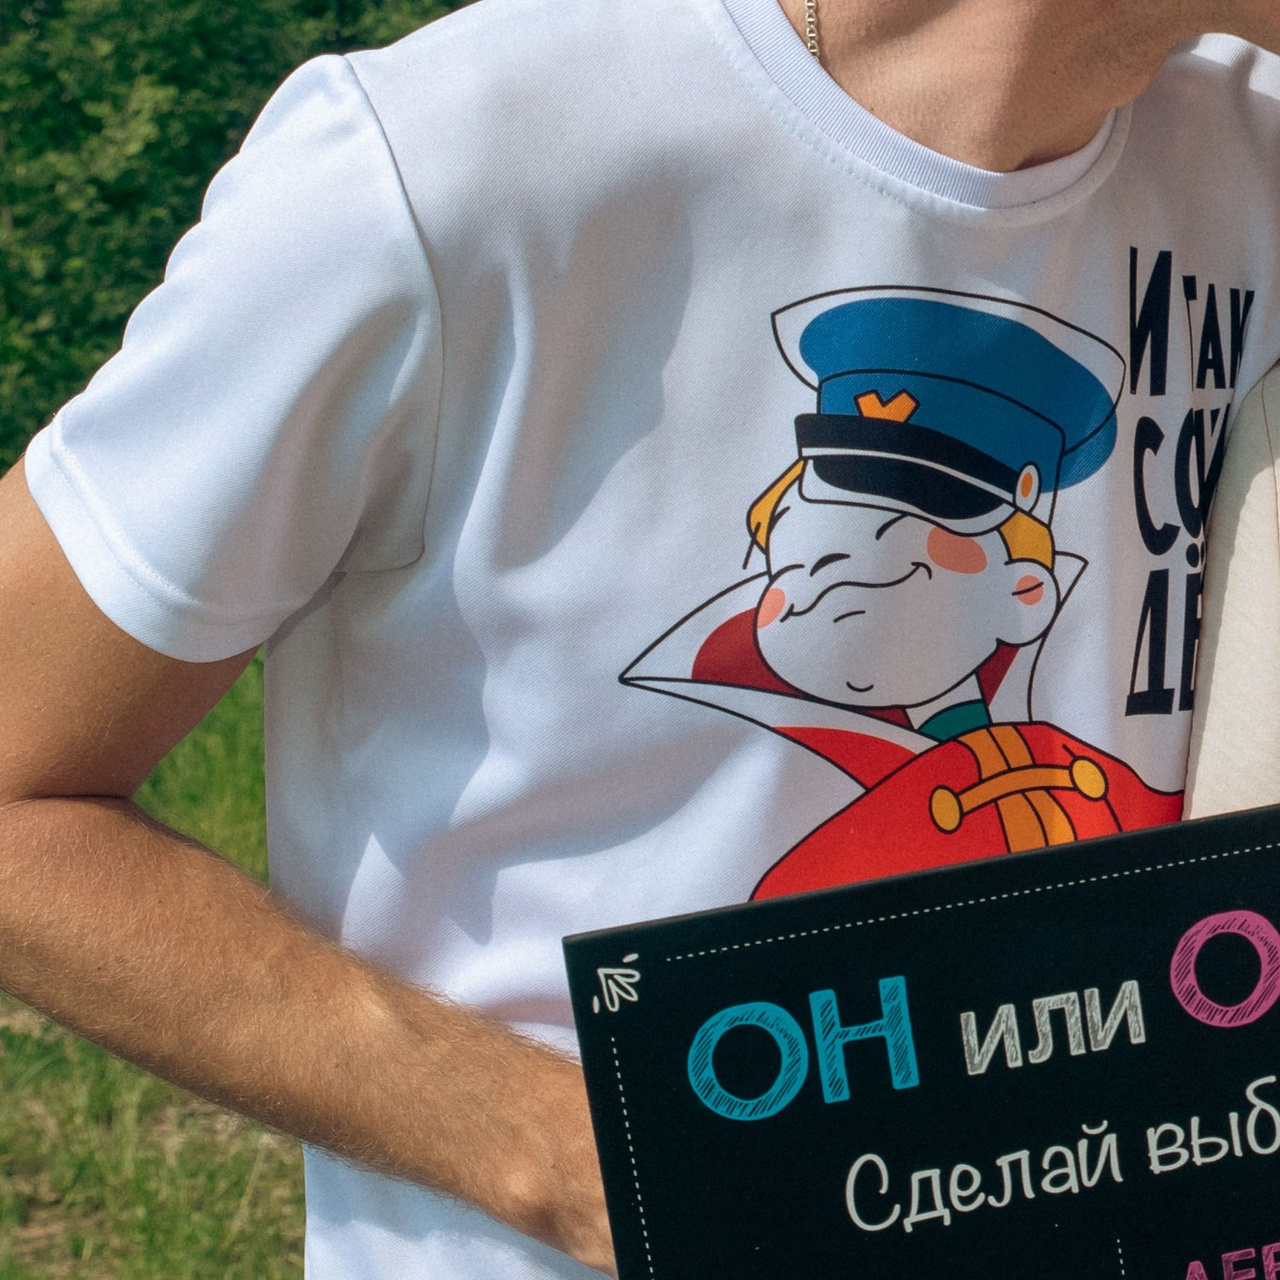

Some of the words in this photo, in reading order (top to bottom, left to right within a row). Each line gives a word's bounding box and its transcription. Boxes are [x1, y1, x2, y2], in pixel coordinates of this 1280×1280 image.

[687, 975, 920, 1121] ОН
[959, 979, 1147, 1076] или
[845, 1119, 1124, 1233] Сделай
